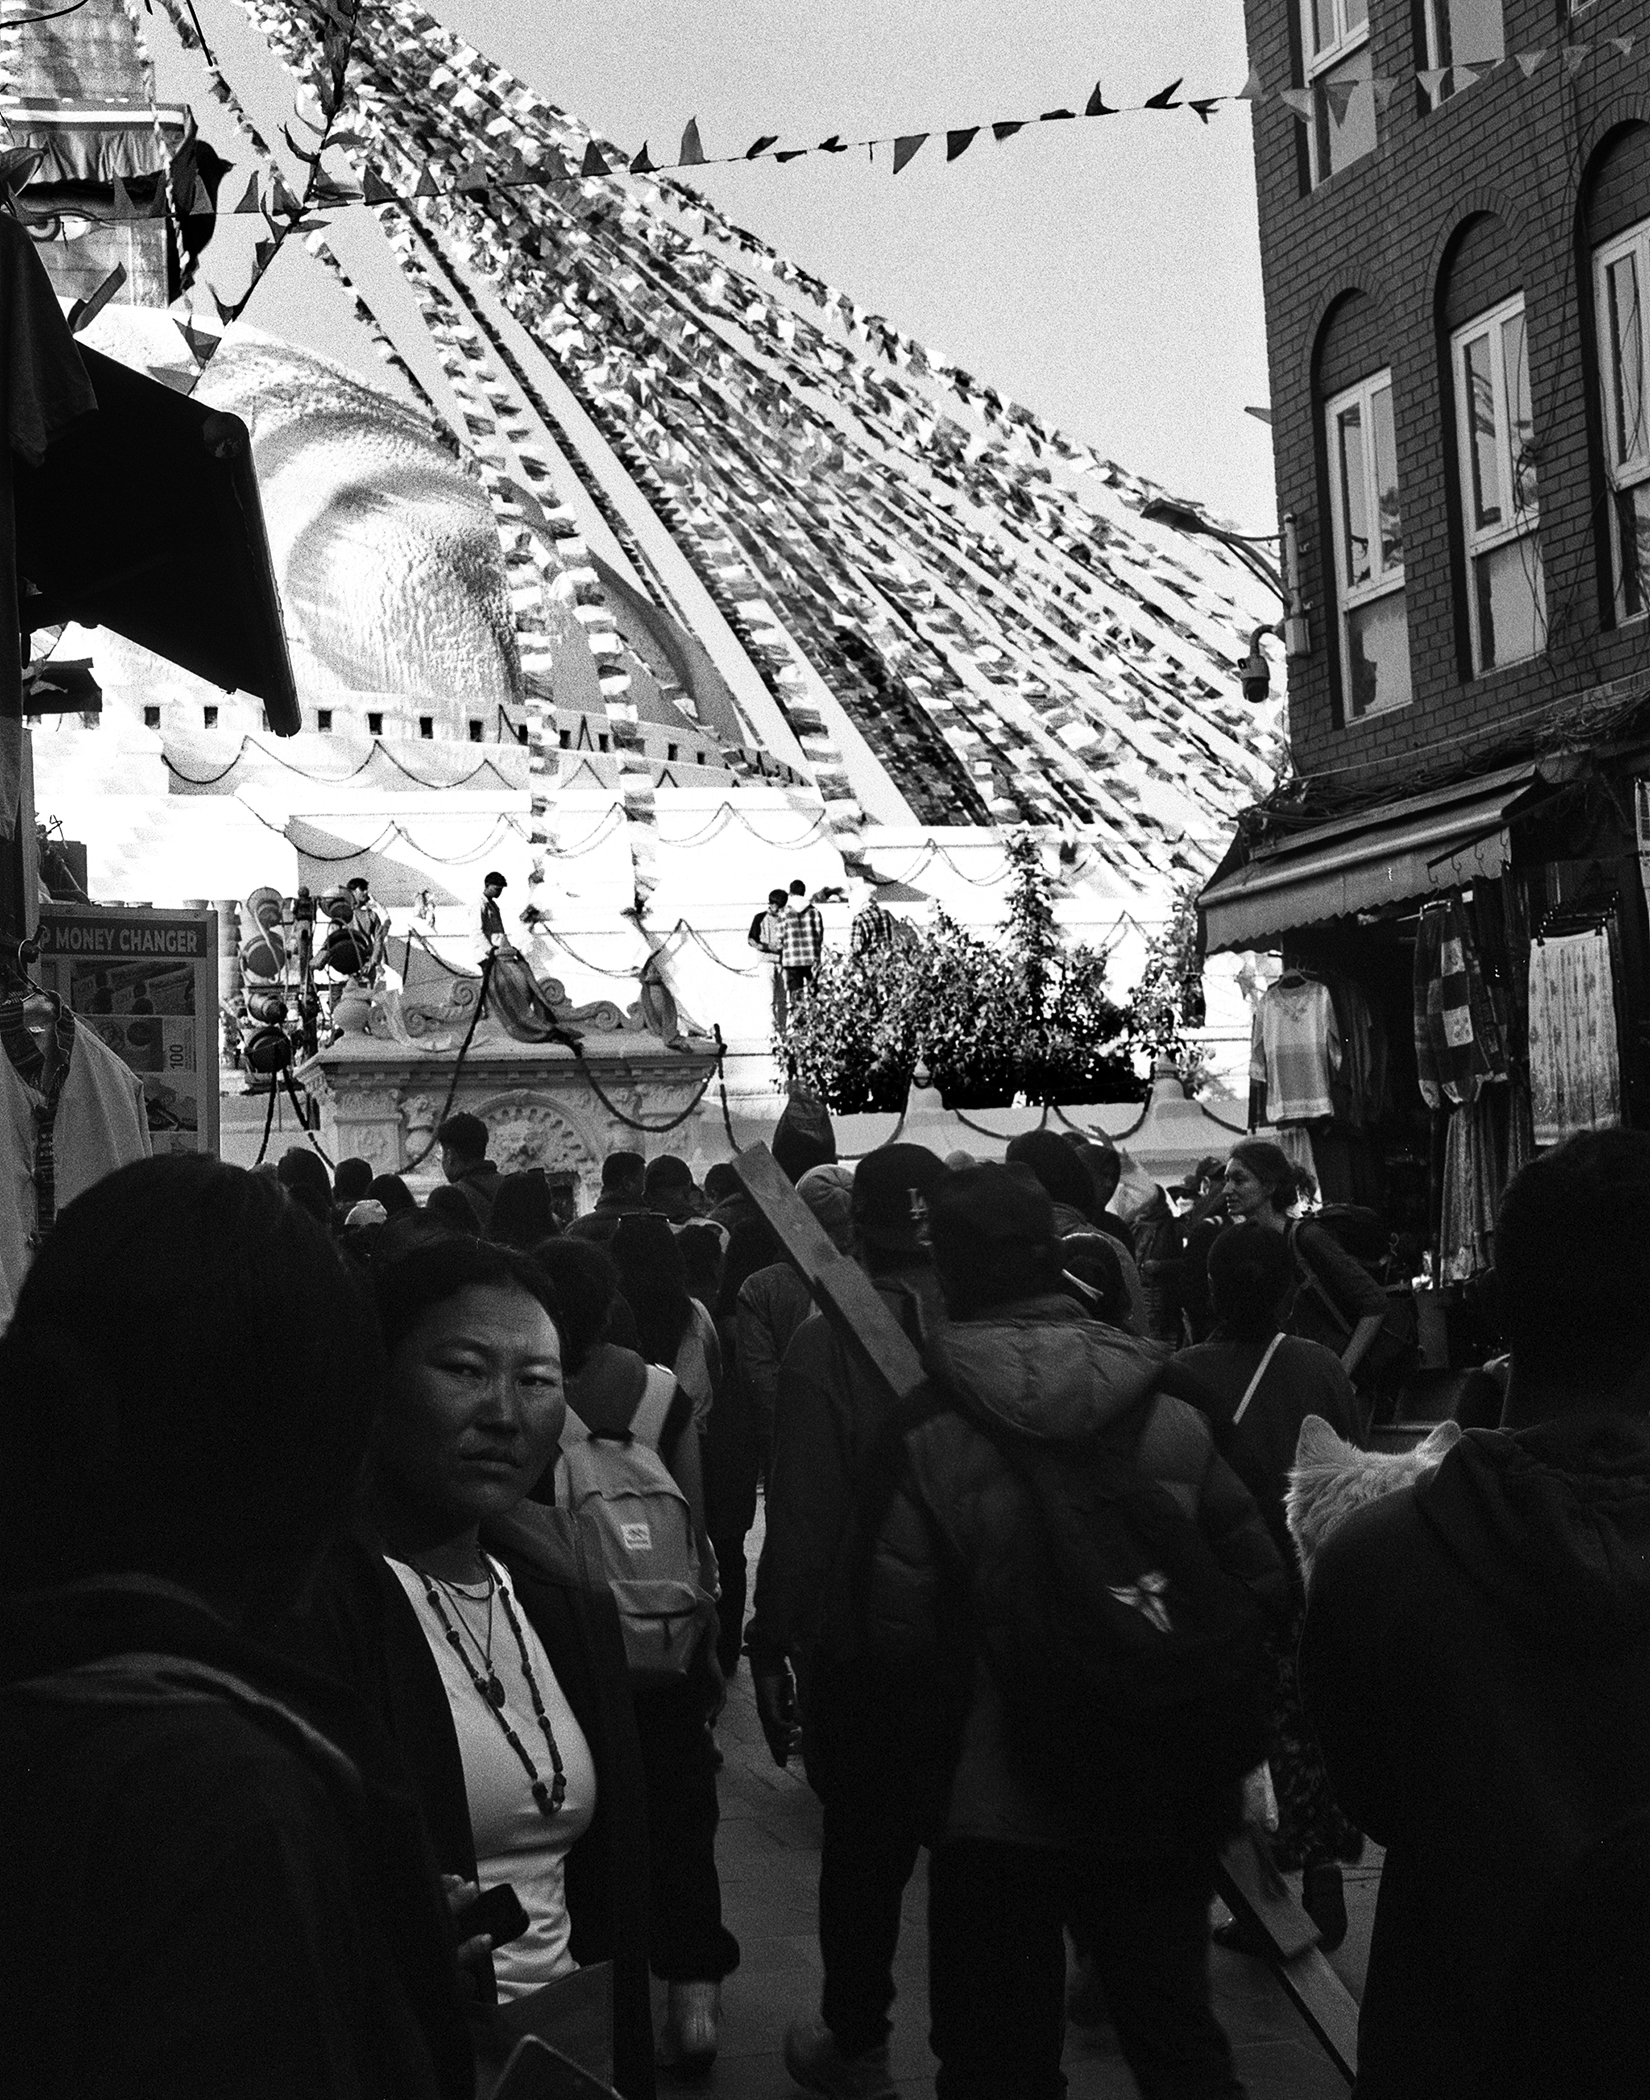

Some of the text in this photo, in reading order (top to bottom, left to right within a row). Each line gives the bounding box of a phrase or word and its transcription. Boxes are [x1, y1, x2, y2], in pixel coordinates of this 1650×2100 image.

[56, 927, 114, 950] MONEY
[120, 928, 197, 953] CHANGER
[170, 1041, 183, 1069] 100
